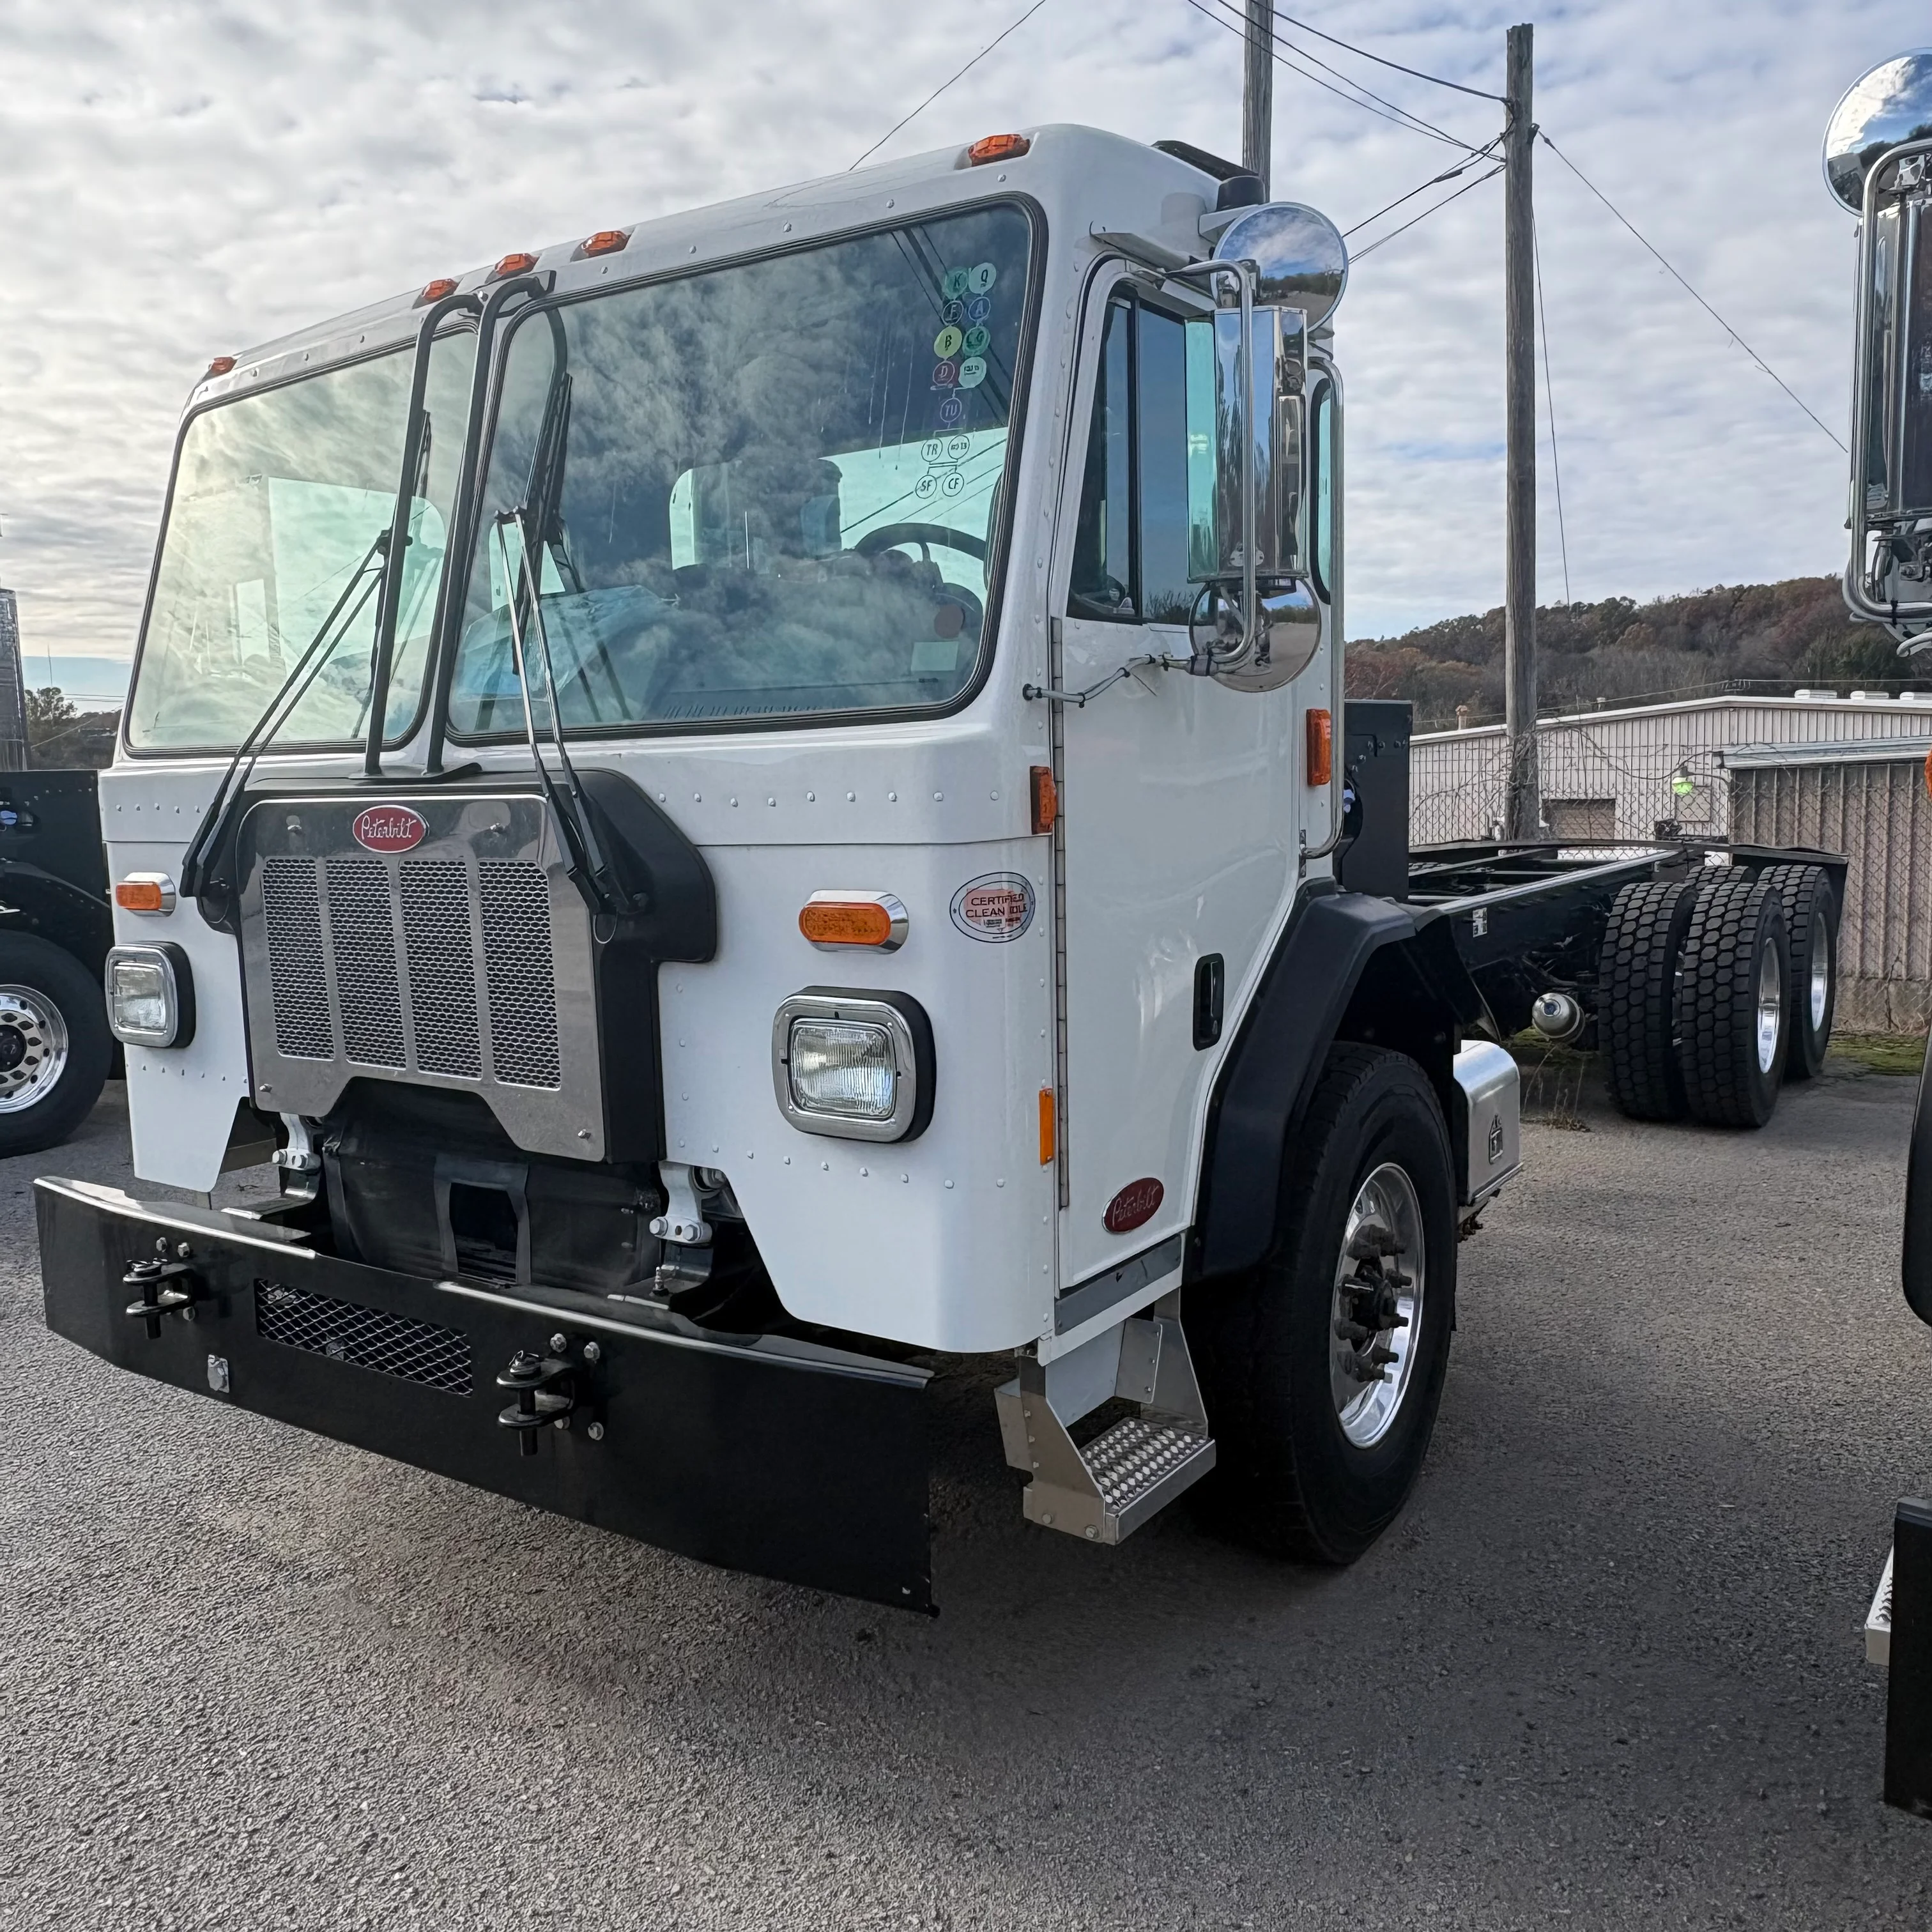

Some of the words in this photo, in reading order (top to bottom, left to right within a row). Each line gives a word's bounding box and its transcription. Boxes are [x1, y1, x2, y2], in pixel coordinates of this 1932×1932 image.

[927, 443, 938, 456] TR
[920, 480, 933, 492] SF
[948, 478, 960, 489] CF
[361, 815, 417, 840] Peterbilt
[970, 893, 1025, 906] CERTIFIED
[965, 907, 1005, 918] CLEAN
